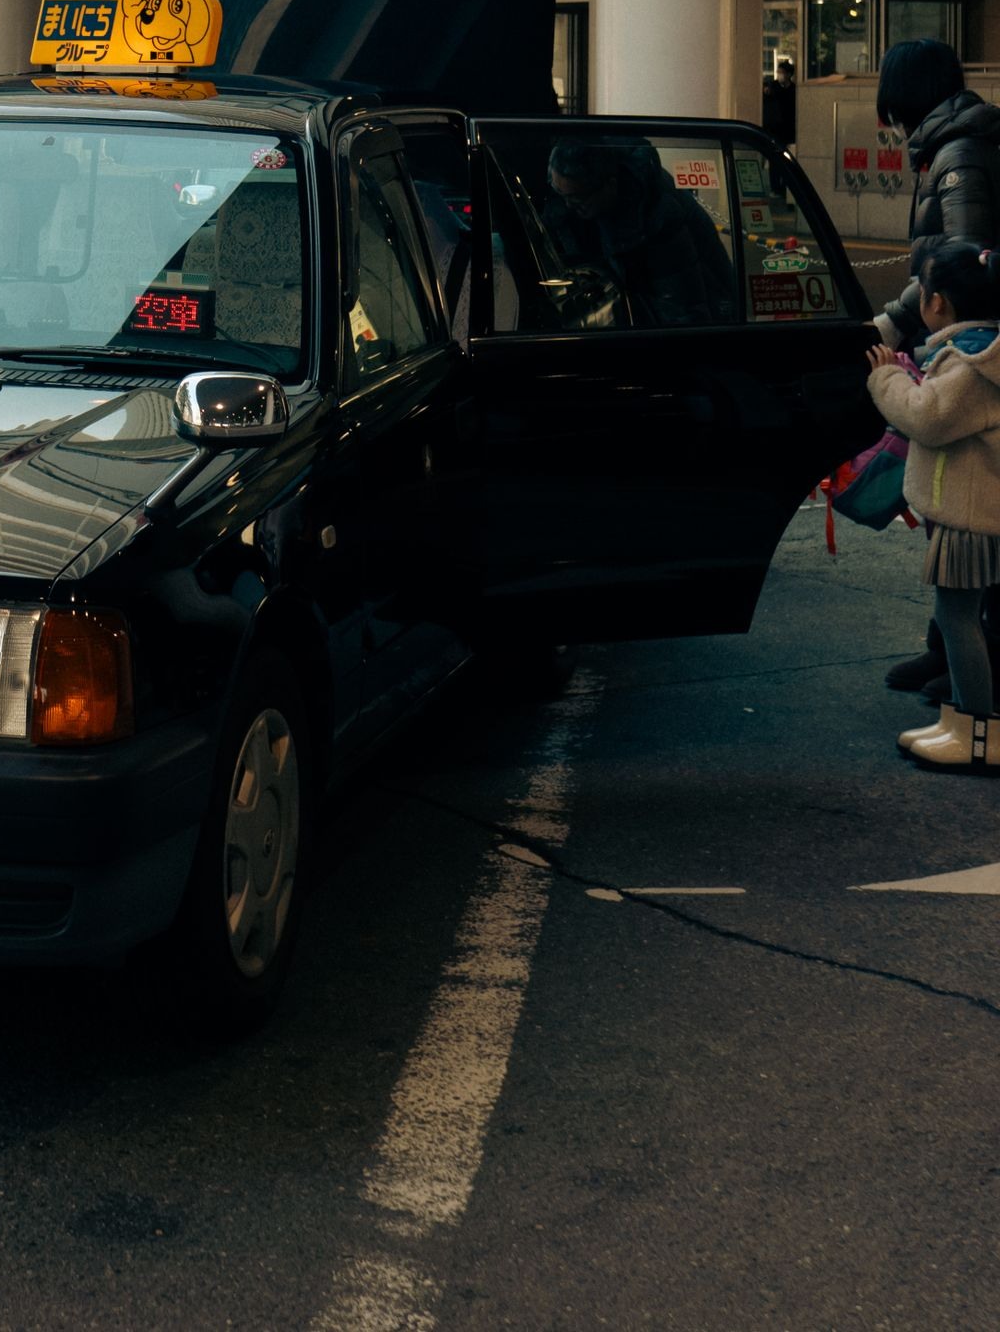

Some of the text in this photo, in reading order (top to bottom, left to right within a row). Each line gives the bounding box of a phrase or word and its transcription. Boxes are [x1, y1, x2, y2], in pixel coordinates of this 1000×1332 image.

[43, 4, 112, 37] まいにち
[56, 42, 110, 62] グループ
[135, 293, 200, 331] 空車
